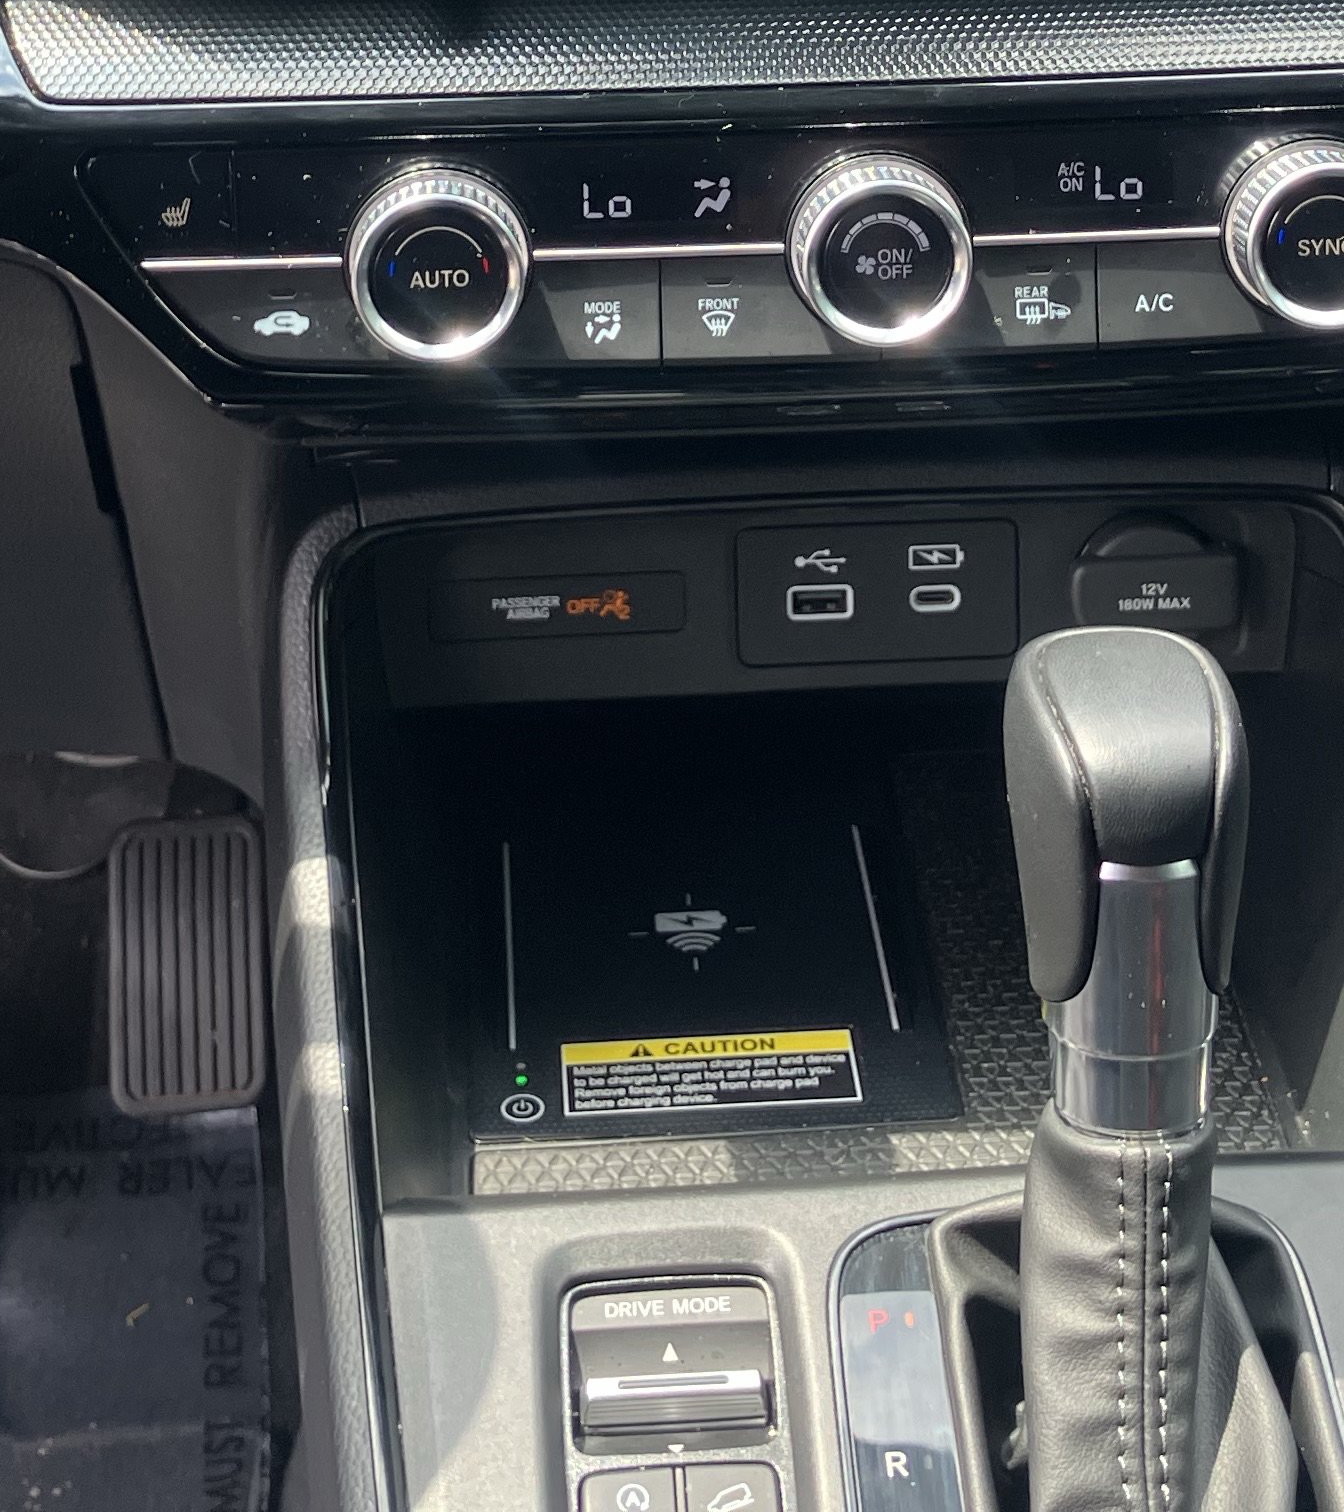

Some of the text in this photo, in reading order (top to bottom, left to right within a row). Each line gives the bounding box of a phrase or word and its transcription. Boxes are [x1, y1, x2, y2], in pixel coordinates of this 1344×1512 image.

[1058, 163, 1085, 177] A/C
[1060, 178, 1083, 192] ON
[878, 248, 913, 263] ON/
[409, 269, 470, 290] AUTO
[878, 265, 913, 280] OFF
[1014, 286, 1048, 298] REAR
[584, 301, 622, 314] MODE
[697, 298, 740, 311] FRONT
[1135, 294, 1174, 313] A/C
[1141, 583, 1168, 596] 12V
[491, 596, 560, 610] PASSENGER
[566, 598, 601, 614] OFF
[1157, 597, 1191, 609] MAX
[506, 607, 550, 619] AIRBAG
[664, 1037, 776, 1055] CAUTION
[572, 1054, 846, 1076] Metal objects between charge pad and device
[588, 1077, 605, 1086] be
[607, 1074, 657, 1086] charged
[682, 1072, 702, 1083] get
[726, 1069, 750, 1079] and
[752, 1069, 776, 1077] can
[777, 1066, 806, 1076] burn
[574, 1076, 819, 1098] Remove foreign objects from charge pad
[575, 1099, 615, 1109] before
[617, 1096, 671, 1108] charging
[203, 1203, 250, 1388] REMOVE
[604, 1296, 731, 1318] DRIVE MODE
[868, 1310, 888, 1334] P
[885, 1451, 909, 1478] R
